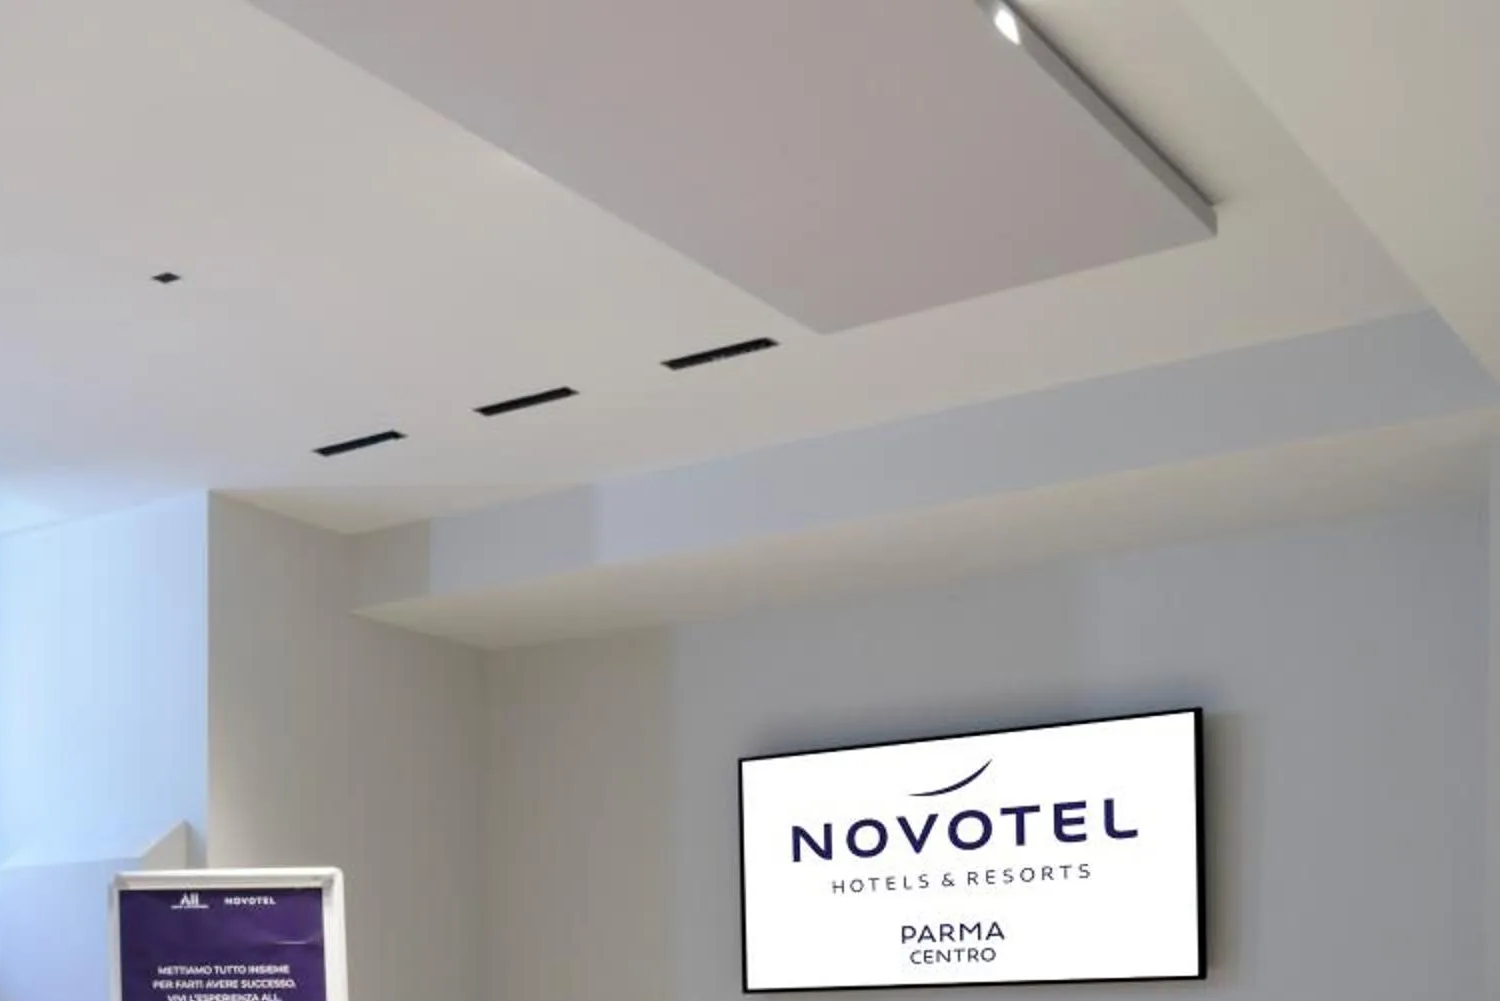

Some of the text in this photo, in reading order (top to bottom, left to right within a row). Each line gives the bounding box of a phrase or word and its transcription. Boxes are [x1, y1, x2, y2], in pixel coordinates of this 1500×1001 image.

[791, 797, 1139, 863] NOVOTEL
[831, 863, 1092, 894] HOTELS & RESORTS
[901, 921, 1005, 945] PARMA
[909, 947, 997, 965] CENTRO
[157, 965, 212, 975] METTIAMO
[214, 964, 246, 974] TUTTO
[152, 979, 173, 989] PER
[206, 979, 238, 988] AVERE
